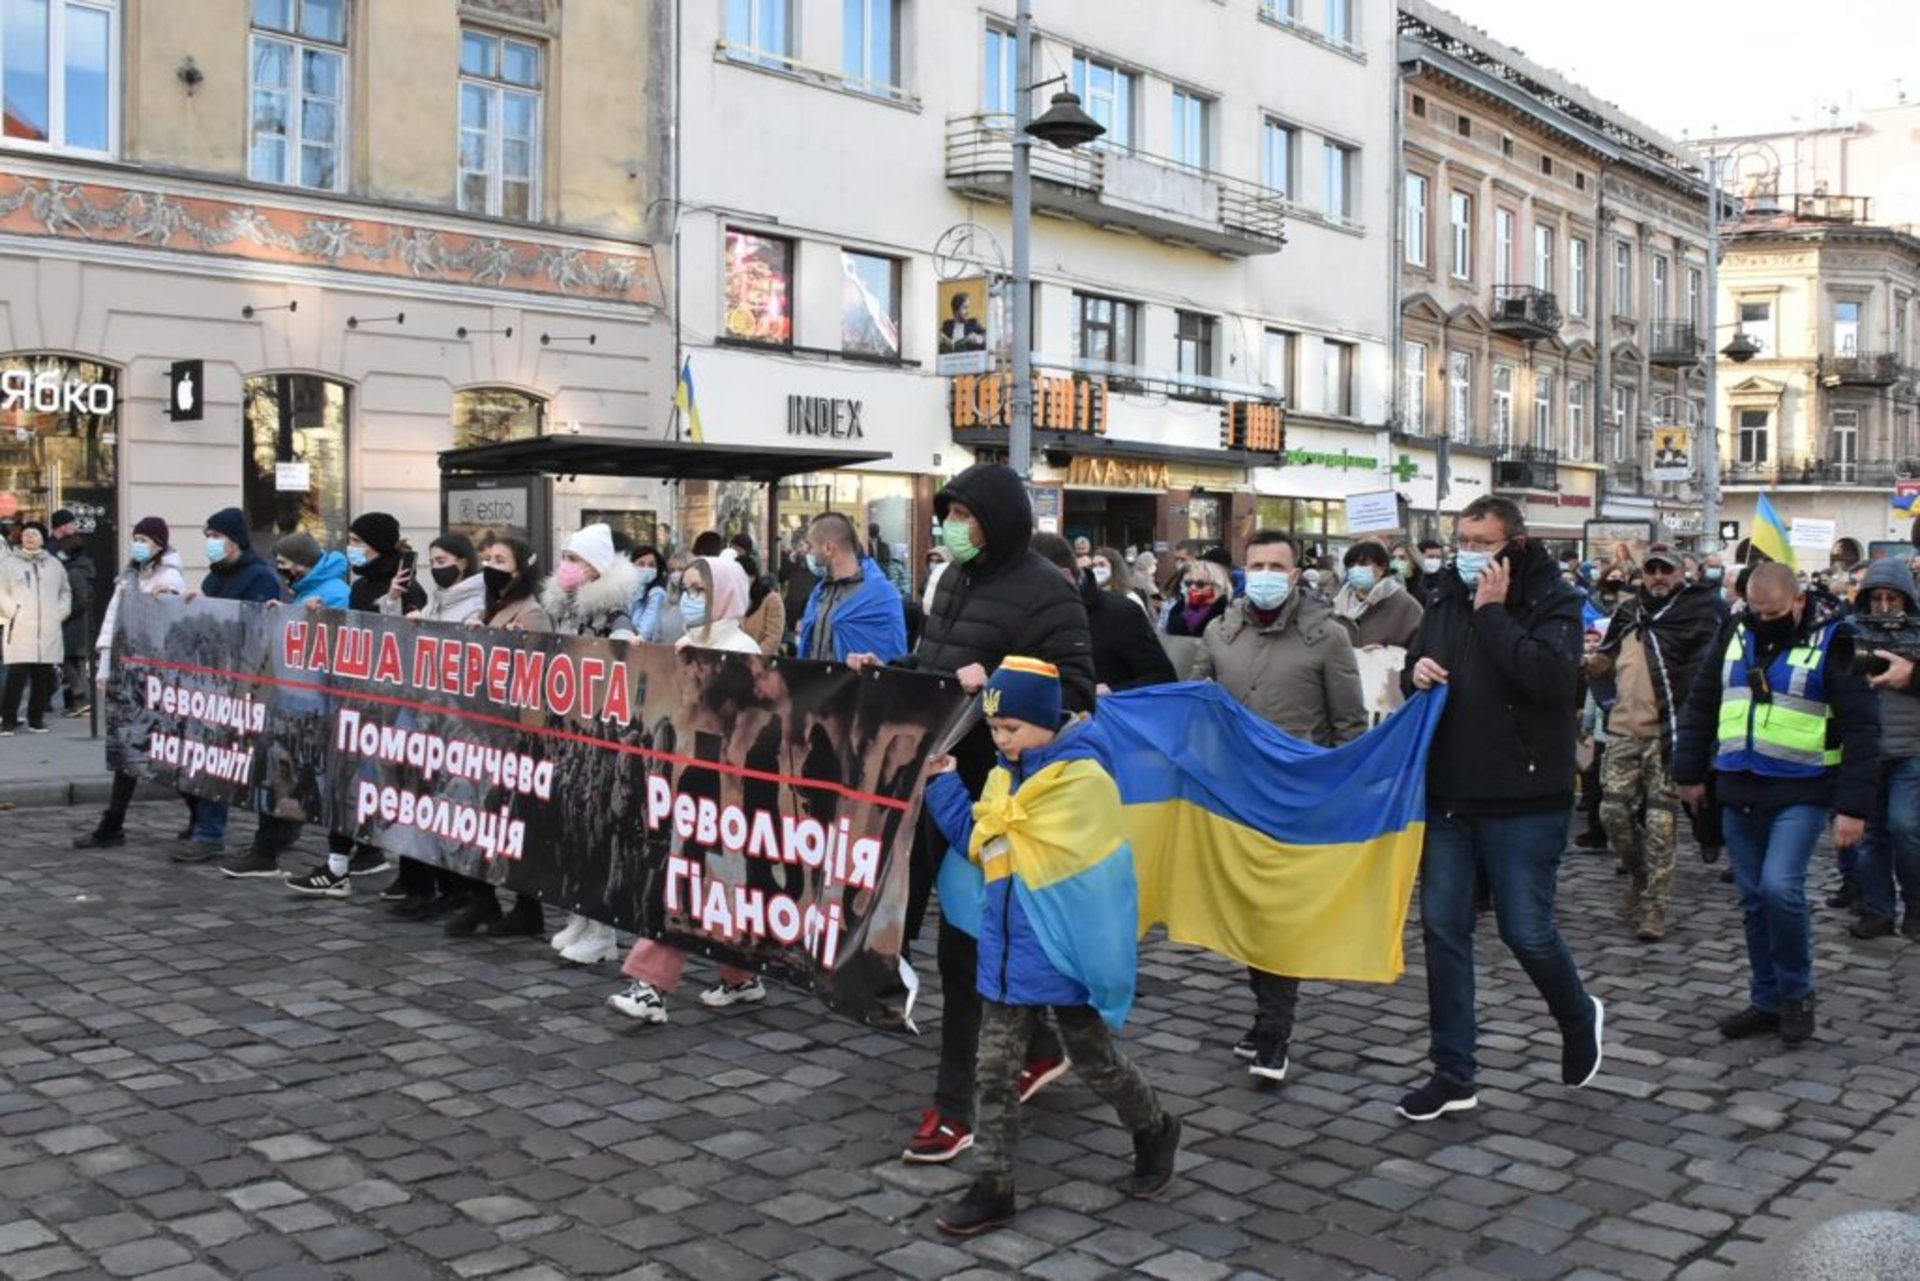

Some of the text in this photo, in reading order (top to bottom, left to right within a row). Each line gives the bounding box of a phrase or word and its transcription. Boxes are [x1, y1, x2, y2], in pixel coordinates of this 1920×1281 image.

[1, 368, 114, 415] Ябко
[787, 394, 864, 438] INDEX
[477, 501, 514, 520] estro
[284, 620, 632, 726] НАША ПЕРЕМОГА
[147, 675, 266, 735] Революція
[151, 732, 254, 785] на граніті
[338, 708, 554, 801] Помаранчева
[357, 780, 525, 860] революція
